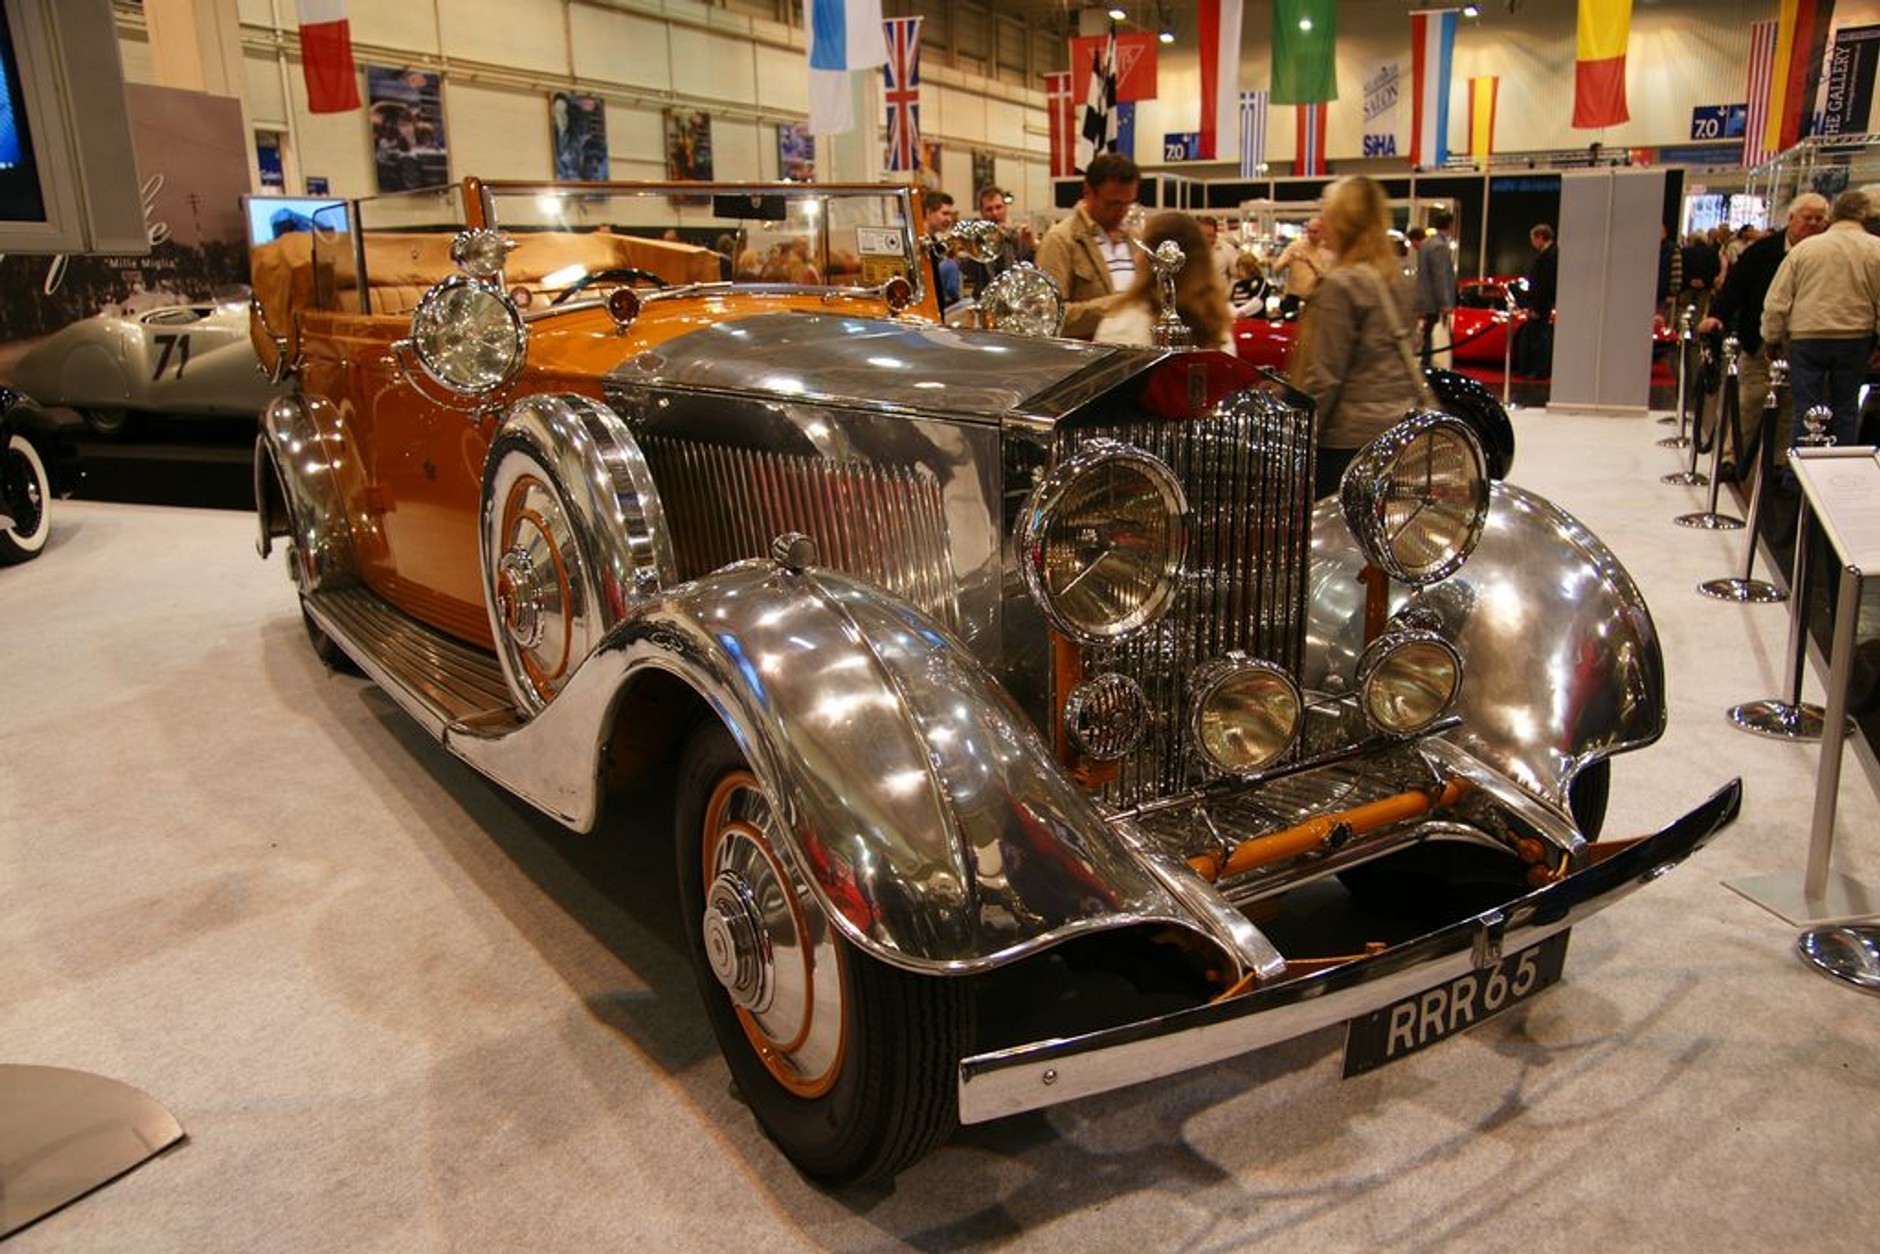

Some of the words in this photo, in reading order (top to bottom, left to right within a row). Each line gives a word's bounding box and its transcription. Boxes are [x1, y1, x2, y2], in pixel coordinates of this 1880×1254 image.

[1828, 46, 1851, 112] GALLERY
[1695, 118, 1719, 138] 7.0
[153, 333, 190, 381] 71
[1385, 974, 1478, 1057] RRR
[1484, 947, 1540, 1011] 65
